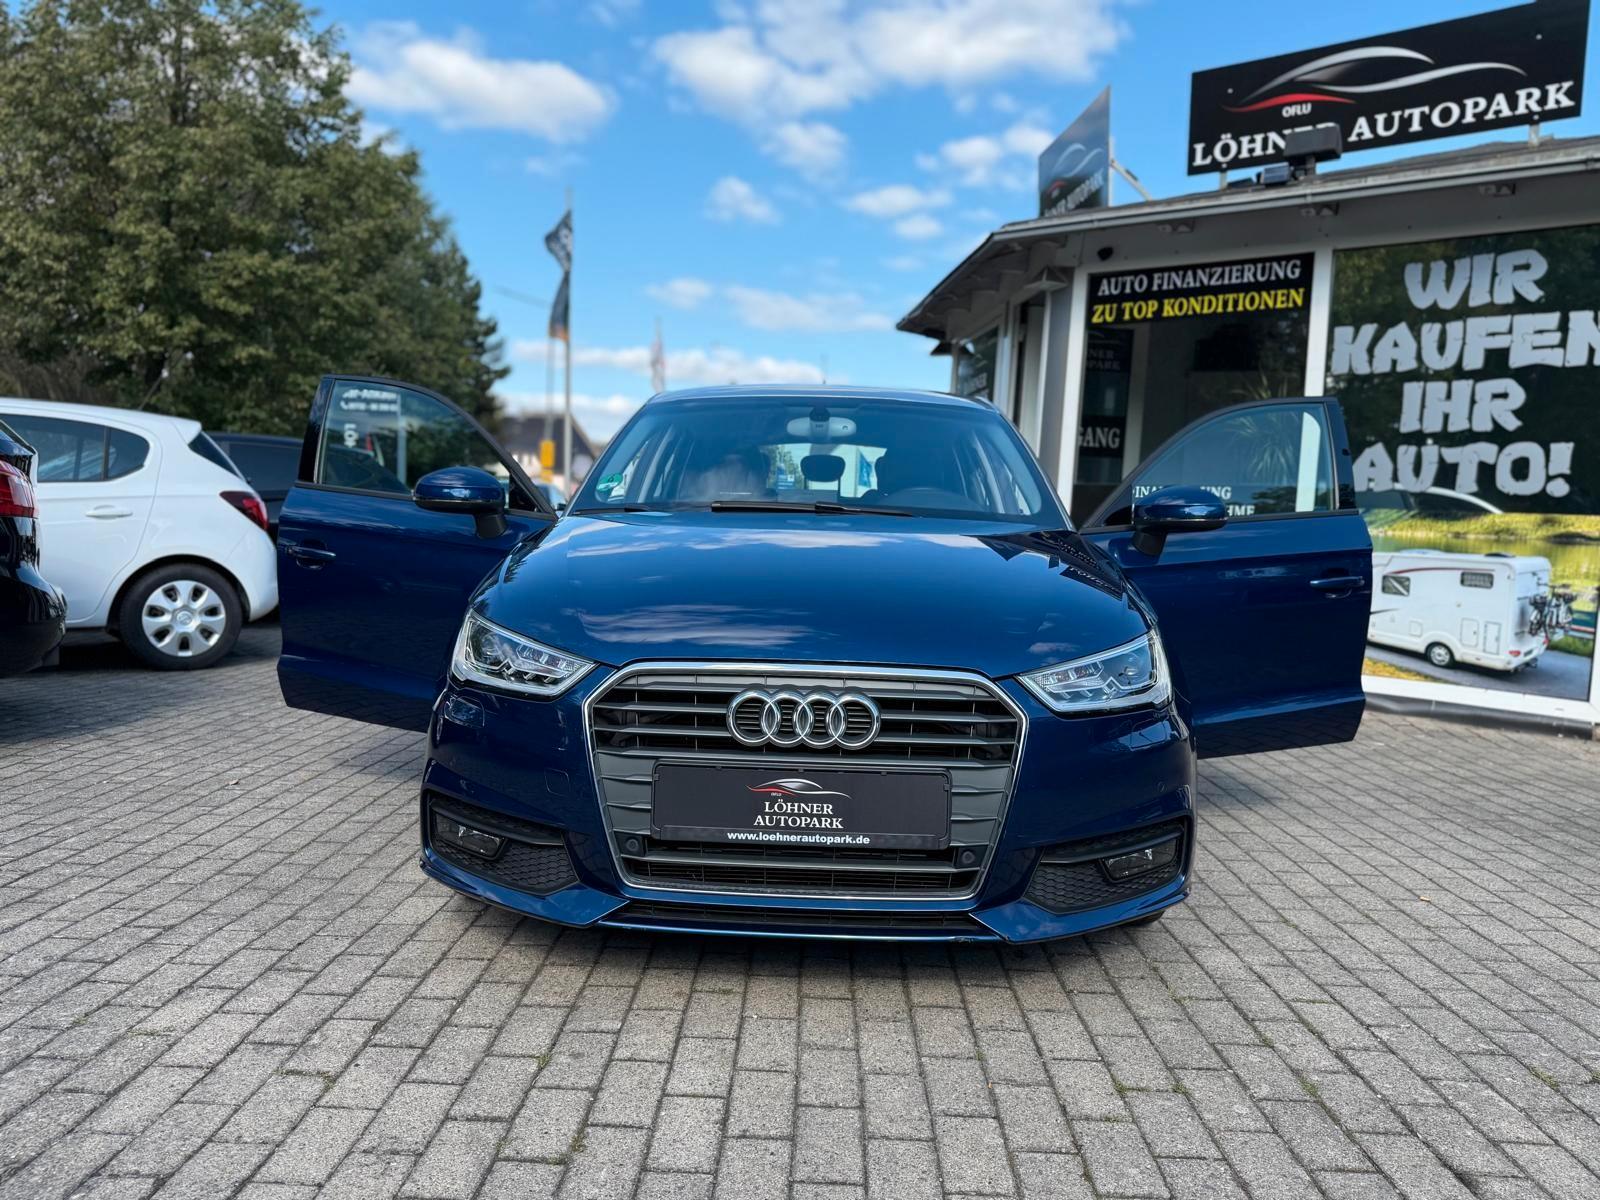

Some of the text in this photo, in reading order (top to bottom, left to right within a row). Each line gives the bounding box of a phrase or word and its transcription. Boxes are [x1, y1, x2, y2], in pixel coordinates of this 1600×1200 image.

[1192, 80, 1576, 167] LÖHN AUTOPARK
[1097, 258, 1302, 296] AUTO FINANZIERUNG
[1404, 249, 1549, 310] WIR
[1091, 287, 1306, 324] ZU TOP KONDITIONEN
[1330, 309, 1600, 376] KAUFEN
[1399, 378, 1527, 434] IHR
[1352, 441, 1575, 498] AUTO!
[753, 815, 845, 829] AUTOPARK
[764, 799, 834, 815] LÖHNER
[727, 831, 871, 845] www.loehnerautopark.de
